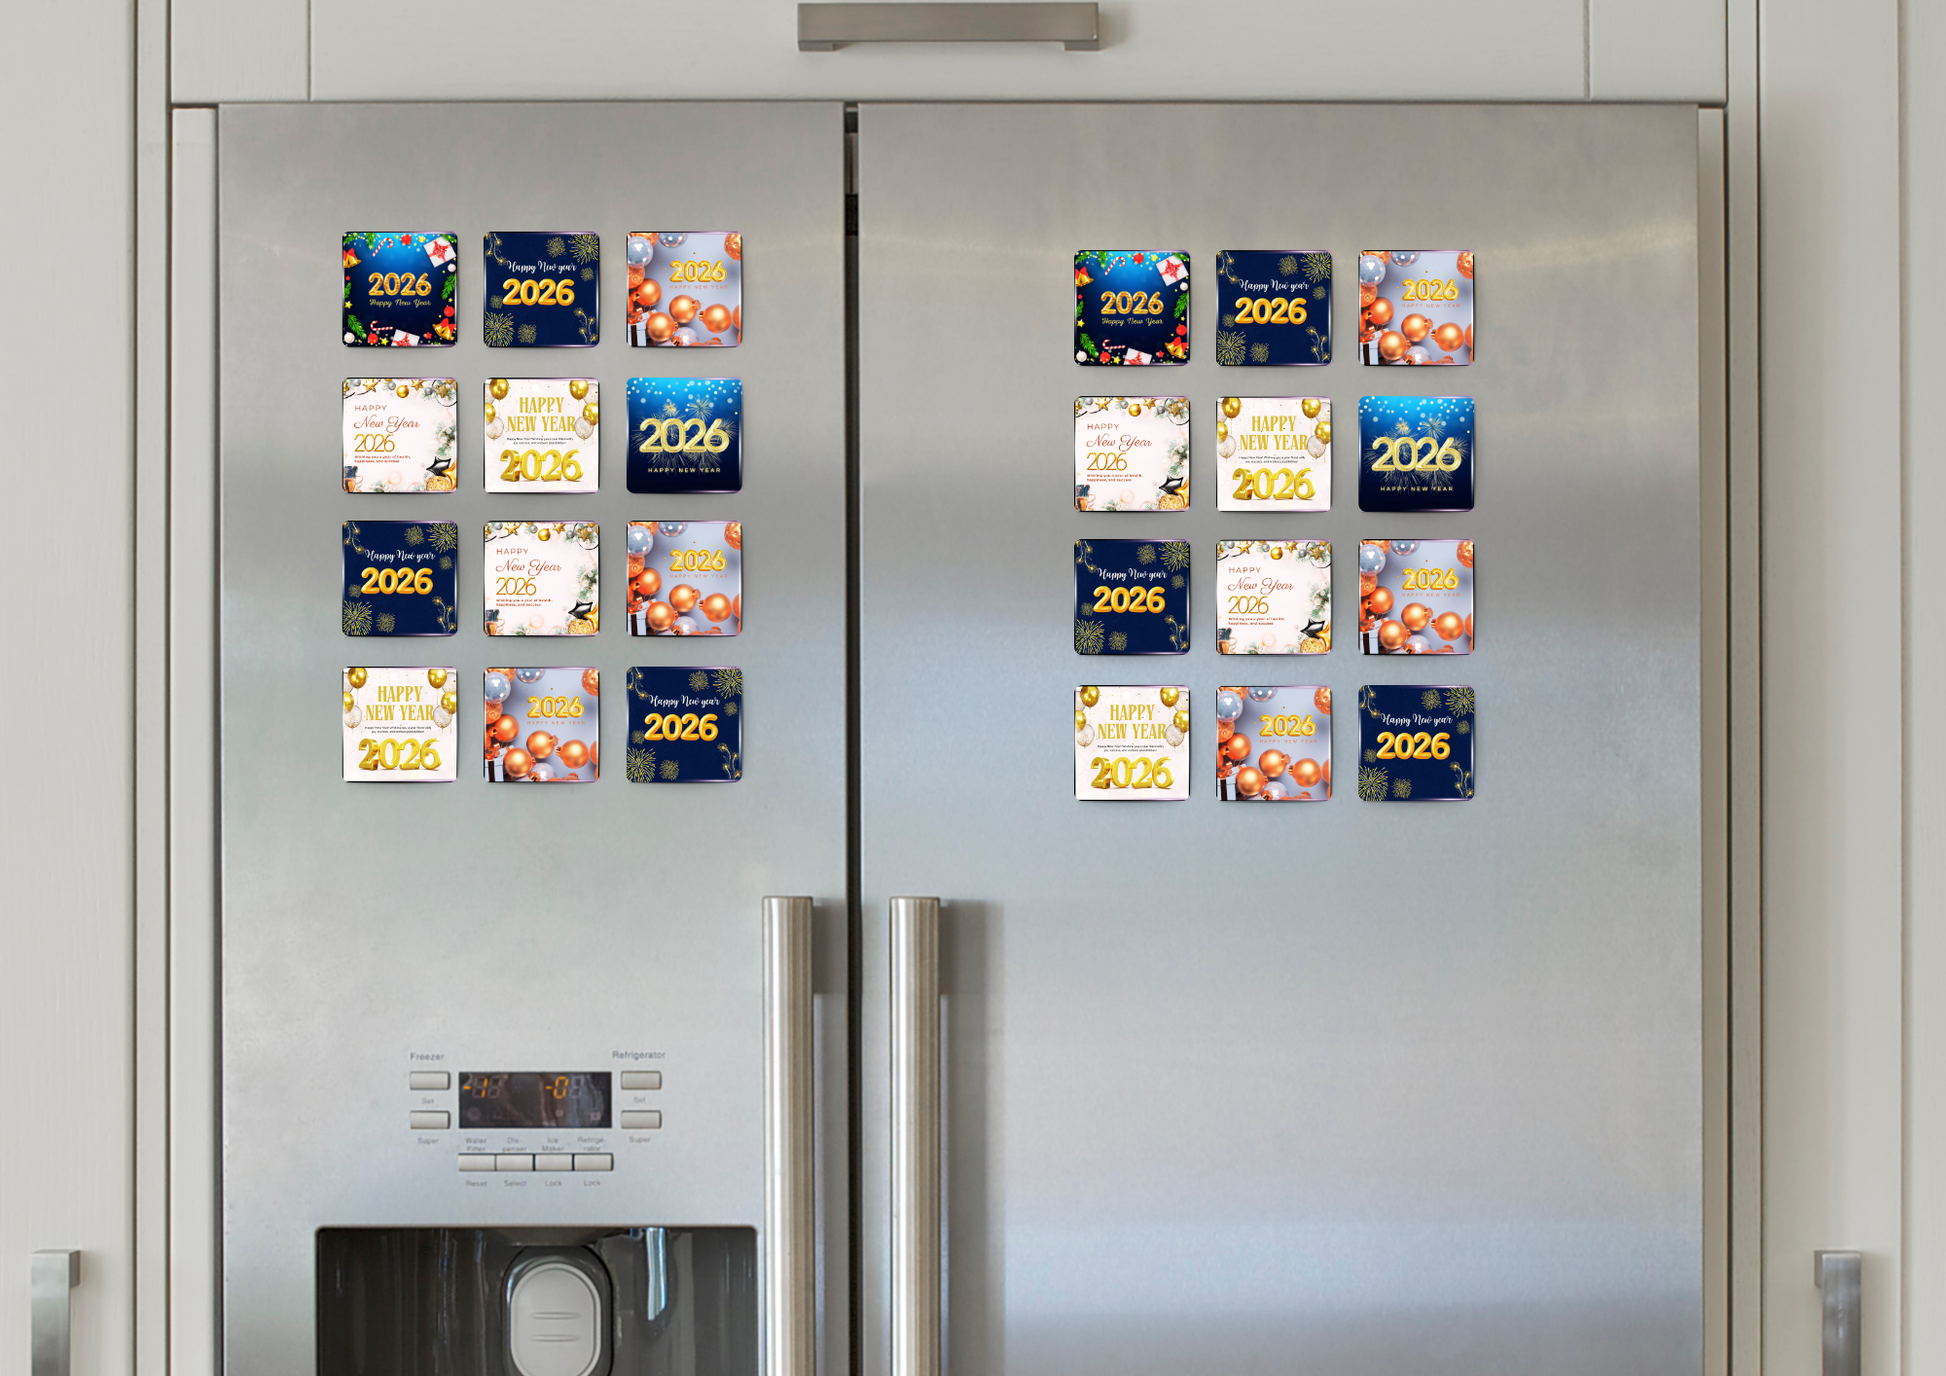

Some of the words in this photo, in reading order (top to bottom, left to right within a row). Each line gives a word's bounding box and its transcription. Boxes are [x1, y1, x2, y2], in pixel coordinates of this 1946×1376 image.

[507, 260, 536, 274] Happy
[538, 260, 557, 273] New
[557, 262, 577, 274] year
[669, 260, 727, 282] 2026
[368, 272, 432, 296] 2026
[502, 278, 575, 306] 2026
[1239, 279, 1268, 293] Happy
[1270, 279, 1289, 292] New
[1289, 281, 1309, 293] year
[1401, 279, 1459, 301] 2026
[369, 298, 392, 308] Happy
[394, 298, 411, 306] New
[413, 298, 432, 308] Year
[1100, 291, 1164, 315] 2026
[1234, 297, 1307, 325] 2026
[1101, 317, 1124, 327] Happy
[1126, 317, 1143, 325] New
[1145, 317, 1164, 327] Year
[519, 396, 564, 413] HAPPY
[353, 414, 384, 429] New
[386, 415, 421, 433] Year
[507, 415, 537, 432] NEW
[541, 415, 576, 432] YEAR
[1251, 415, 1296, 432] HAPPY
[354, 433, 395, 452] 2026
[639, 418, 730, 453] 2026
[1085, 433, 1116, 448] New
[1118, 434, 1153, 452] Year
[1239, 434, 1269, 451] NEW
[1273, 434, 1308, 451] YEAR
[1086, 452, 1127, 471] 2026
[1371, 437, 1462, 472] 2026
[500, 449, 584, 482] 2026
[1232, 468, 1316, 501] 2026
[365, 549, 394, 563] Happy
[396, 549, 415, 562] New
[415, 551, 435, 563] year
[669, 549, 727, 571] 2026
[495, 557, 526, 572] New
[528, 558, 563, 576] Year
[1098, 567, 1127, 581] Happy
[1129, 567, 1148, 580] New
[1148, 569, 1168, 581] year
[360, 567, 433, 595] 2026
[496, 576, 537, 595] 2026
[1227, 576, 1258, 591] New
[1260, 577, 1295, 595] Year
[1401, 568, 1459, 590] 2026
[1093, 585, 1166, 613] 2026
[1228, 595, 1269, 614] 2026
[377, 685, 422, 702] HAPPY
[649, 695, 678, 709] Happy
[680, 695, 699, 708] New
[699, 697, 719, 709] year
[365, 704, 395, 721] NEW
[399, 704, 434, 721] YEAR
[526, 696, 584, 718] 2026
[1110, 703, 1155, 720] HAPPY
[644, 713, 717, 741] 2026
[1259, 714, 1317, 736] 2026
[1382, 713, 1411, 727] Happy
[1413, 713, 1432, 726] New
[1432, 715, 1452, 727] year
[1098, 722, 1128, 739] NEW
[1132, 722, 1167, 739] YEAR
[358, 738, 442, 771] 2026
[1377, 731, 1450, 759] 2026
[1091, 756, 1175, 789] 2026
[410, 1052, 444, 1061] Freezer
[612, 1050, 666, 1061] Refrigerator
[421, 1097, 435, 1105] Set
[633, 1096, 646, 1104] Set
[417, 1137, 439, 1146] Super
[629, 1136, 651, 1145] Super
